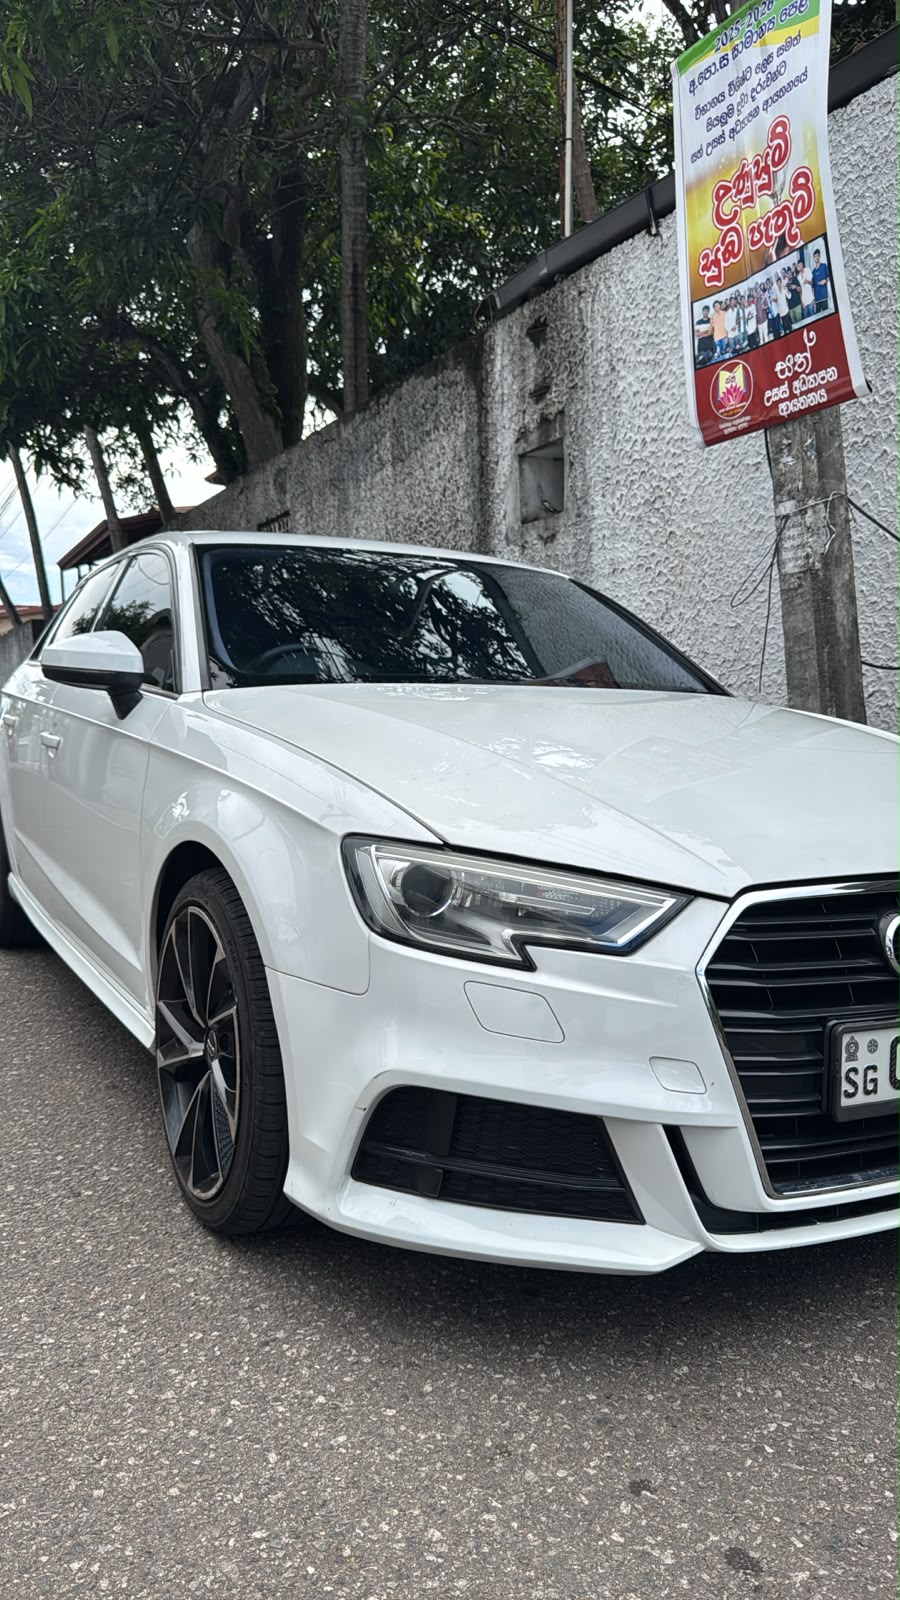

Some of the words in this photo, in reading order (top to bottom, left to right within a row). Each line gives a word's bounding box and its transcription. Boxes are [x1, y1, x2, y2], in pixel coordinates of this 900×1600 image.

[712, 115, 791, 229] උණුසුම්
[749, 166, 815, 249] පැතුම්
[774, 328, 817, 379] සත්
[763, 381, 789, 407] උසස්
[778, 389, 828, 418] ආයතනය
[843, 1064, 878, 1099] SG
